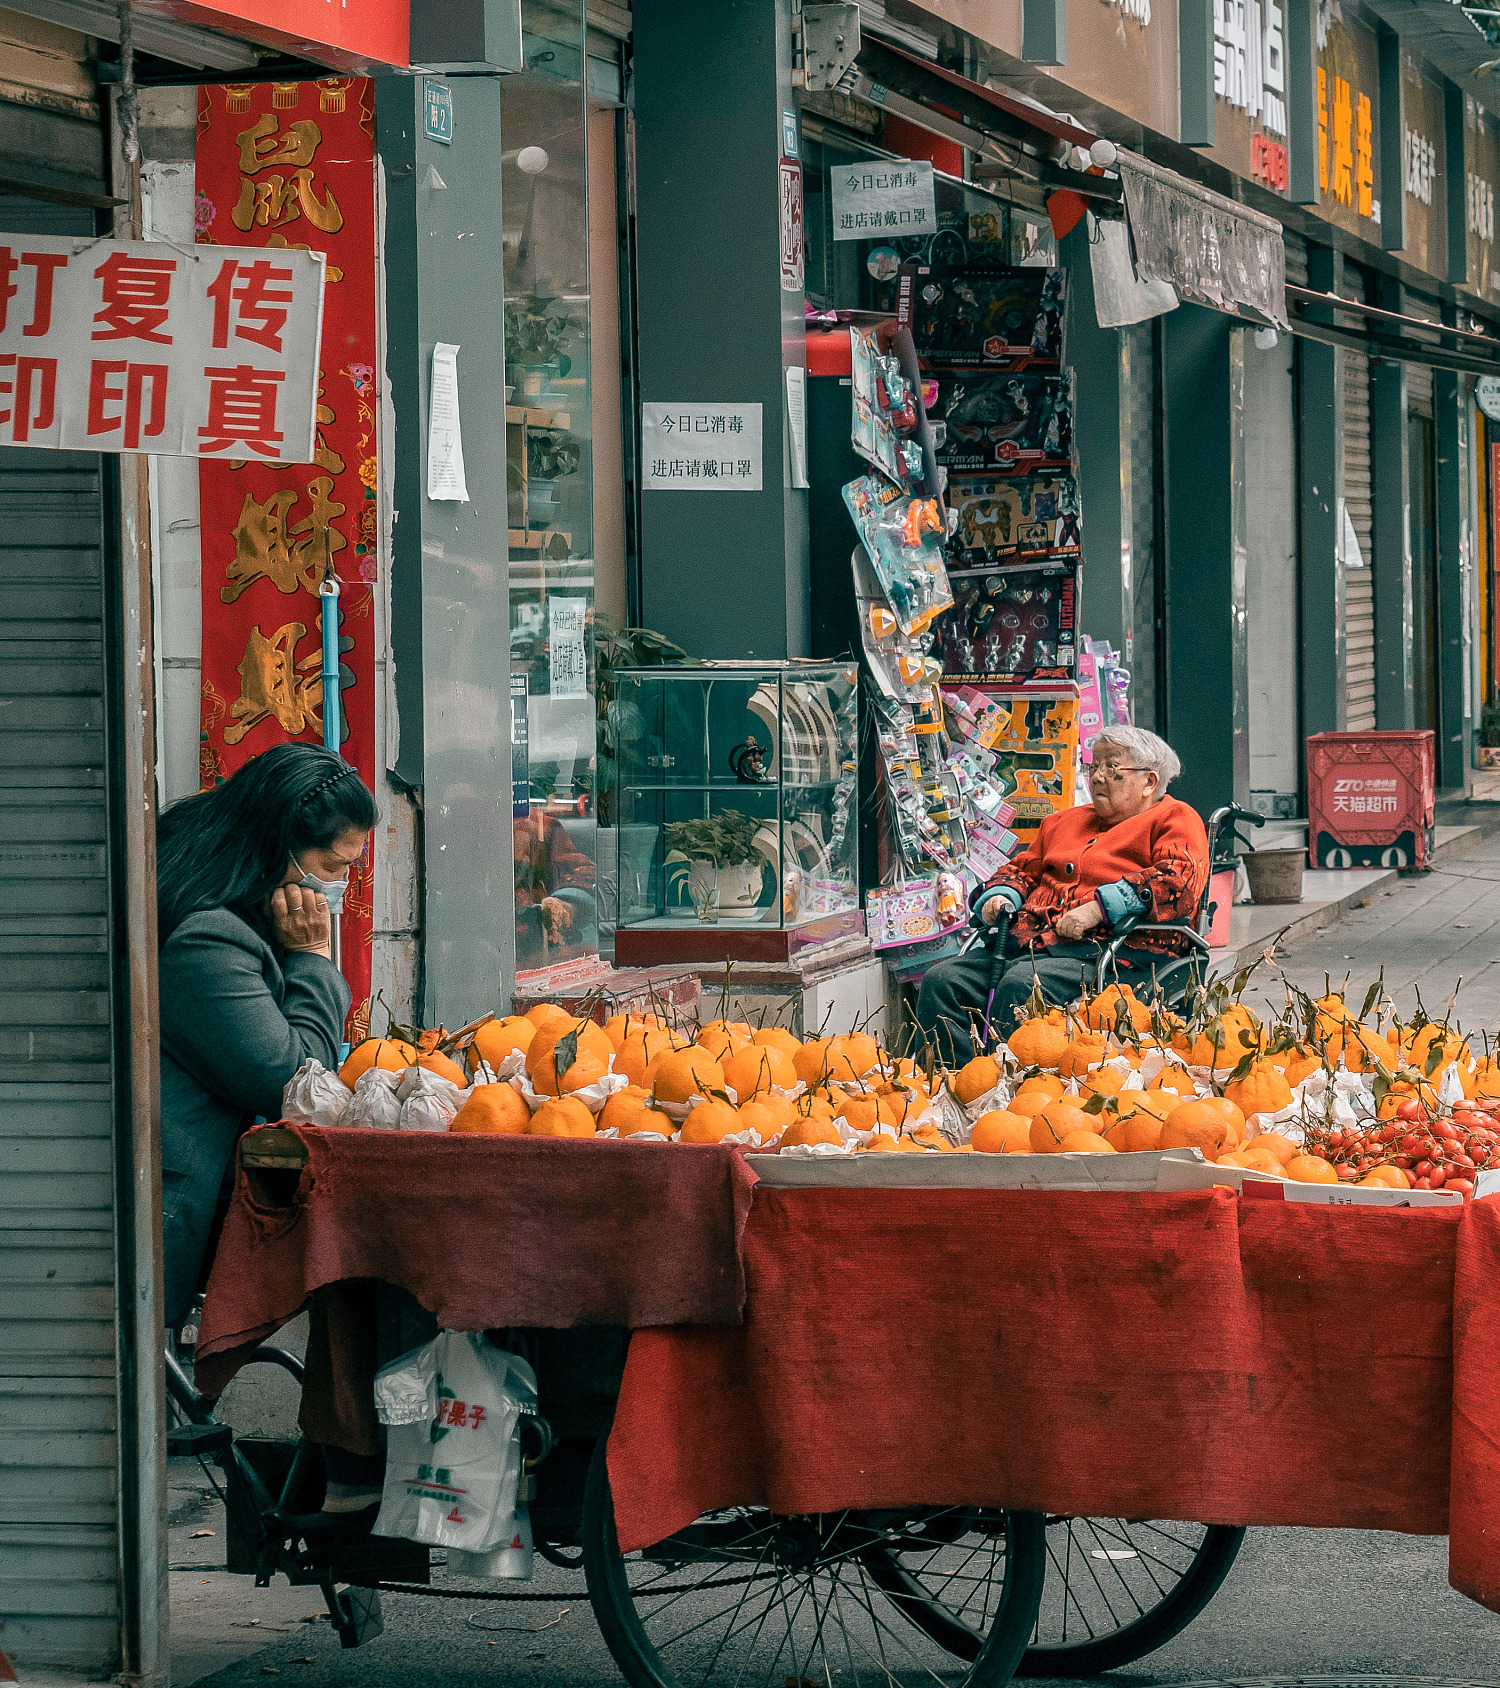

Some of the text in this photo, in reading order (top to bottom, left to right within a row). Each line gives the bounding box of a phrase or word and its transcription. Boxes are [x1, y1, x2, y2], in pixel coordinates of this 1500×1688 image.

[846, 172, 918, 191] 今日已消毒
[840, 208, 927, 229] 进店请戴口罩
[898, 298, 910, 322] SUPER
[659, 414, 744, 434] 今日已消毒
[651, 459, 752, 478] 进店请戴口罩
[1060, 577, 1075, 630] ULTRAMAN
[1333, 779, 1364, 792] ZTO
[1333, 796, 1397, 813] 天猫超市
